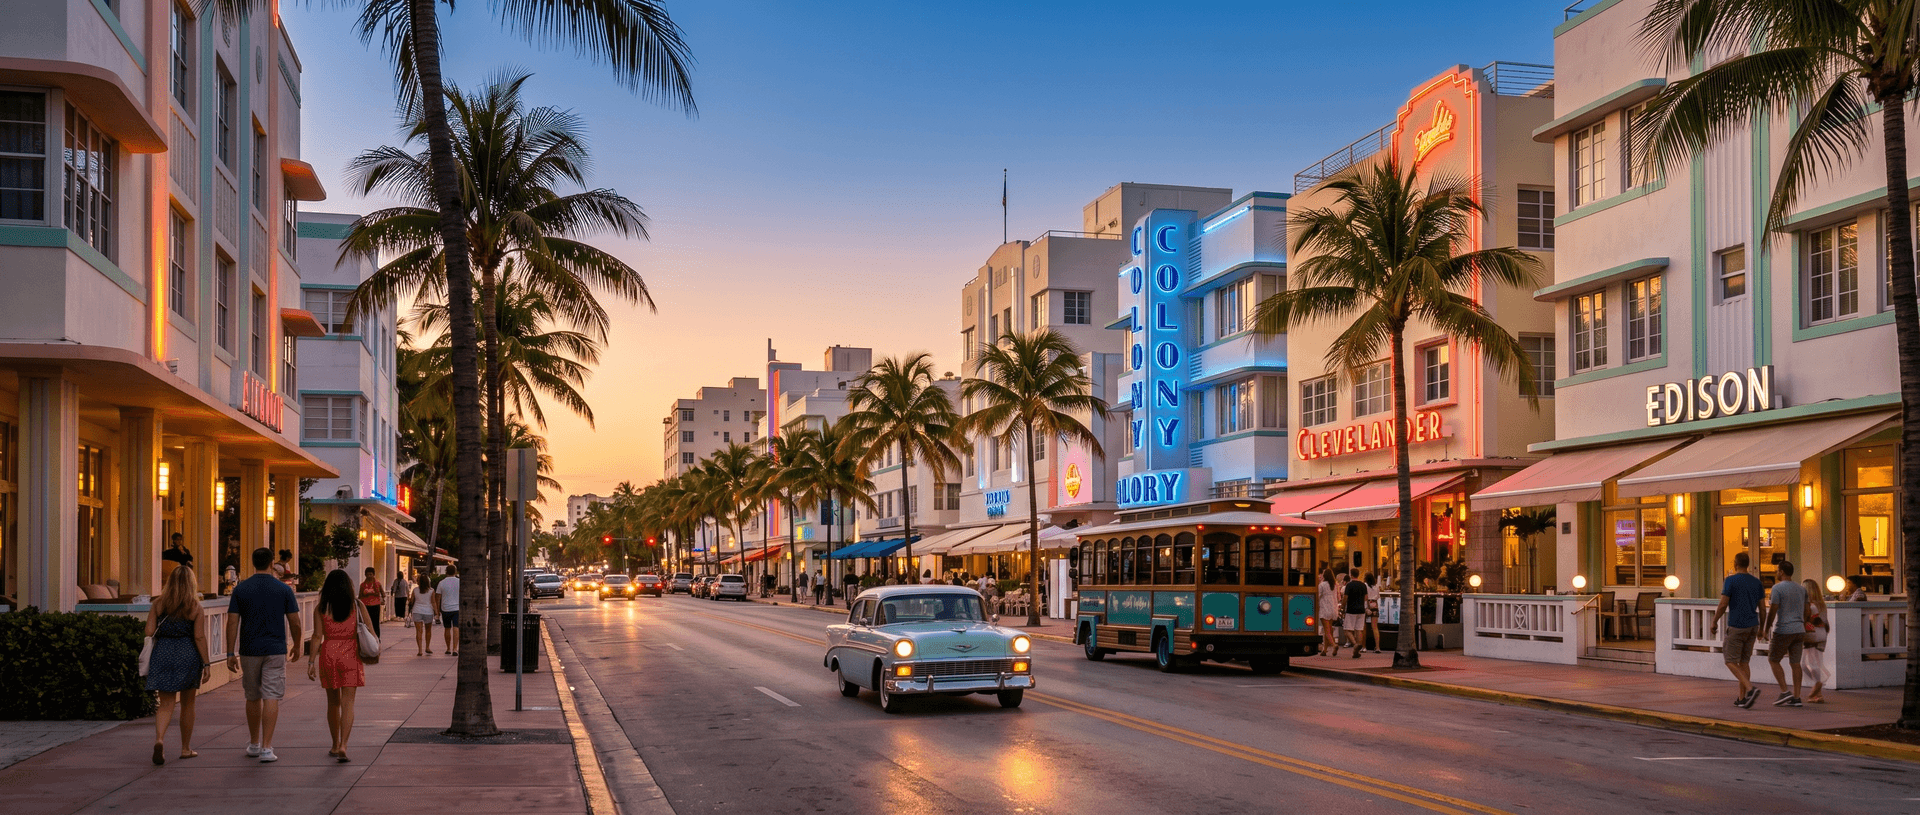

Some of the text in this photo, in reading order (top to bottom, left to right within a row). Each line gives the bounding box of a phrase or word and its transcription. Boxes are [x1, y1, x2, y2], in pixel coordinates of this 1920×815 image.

[1131, 226, 1143, 448] COLONY
[1156, 225, 1180, 447] COLONY
[1646, 365, 1773, 426] EDISON
